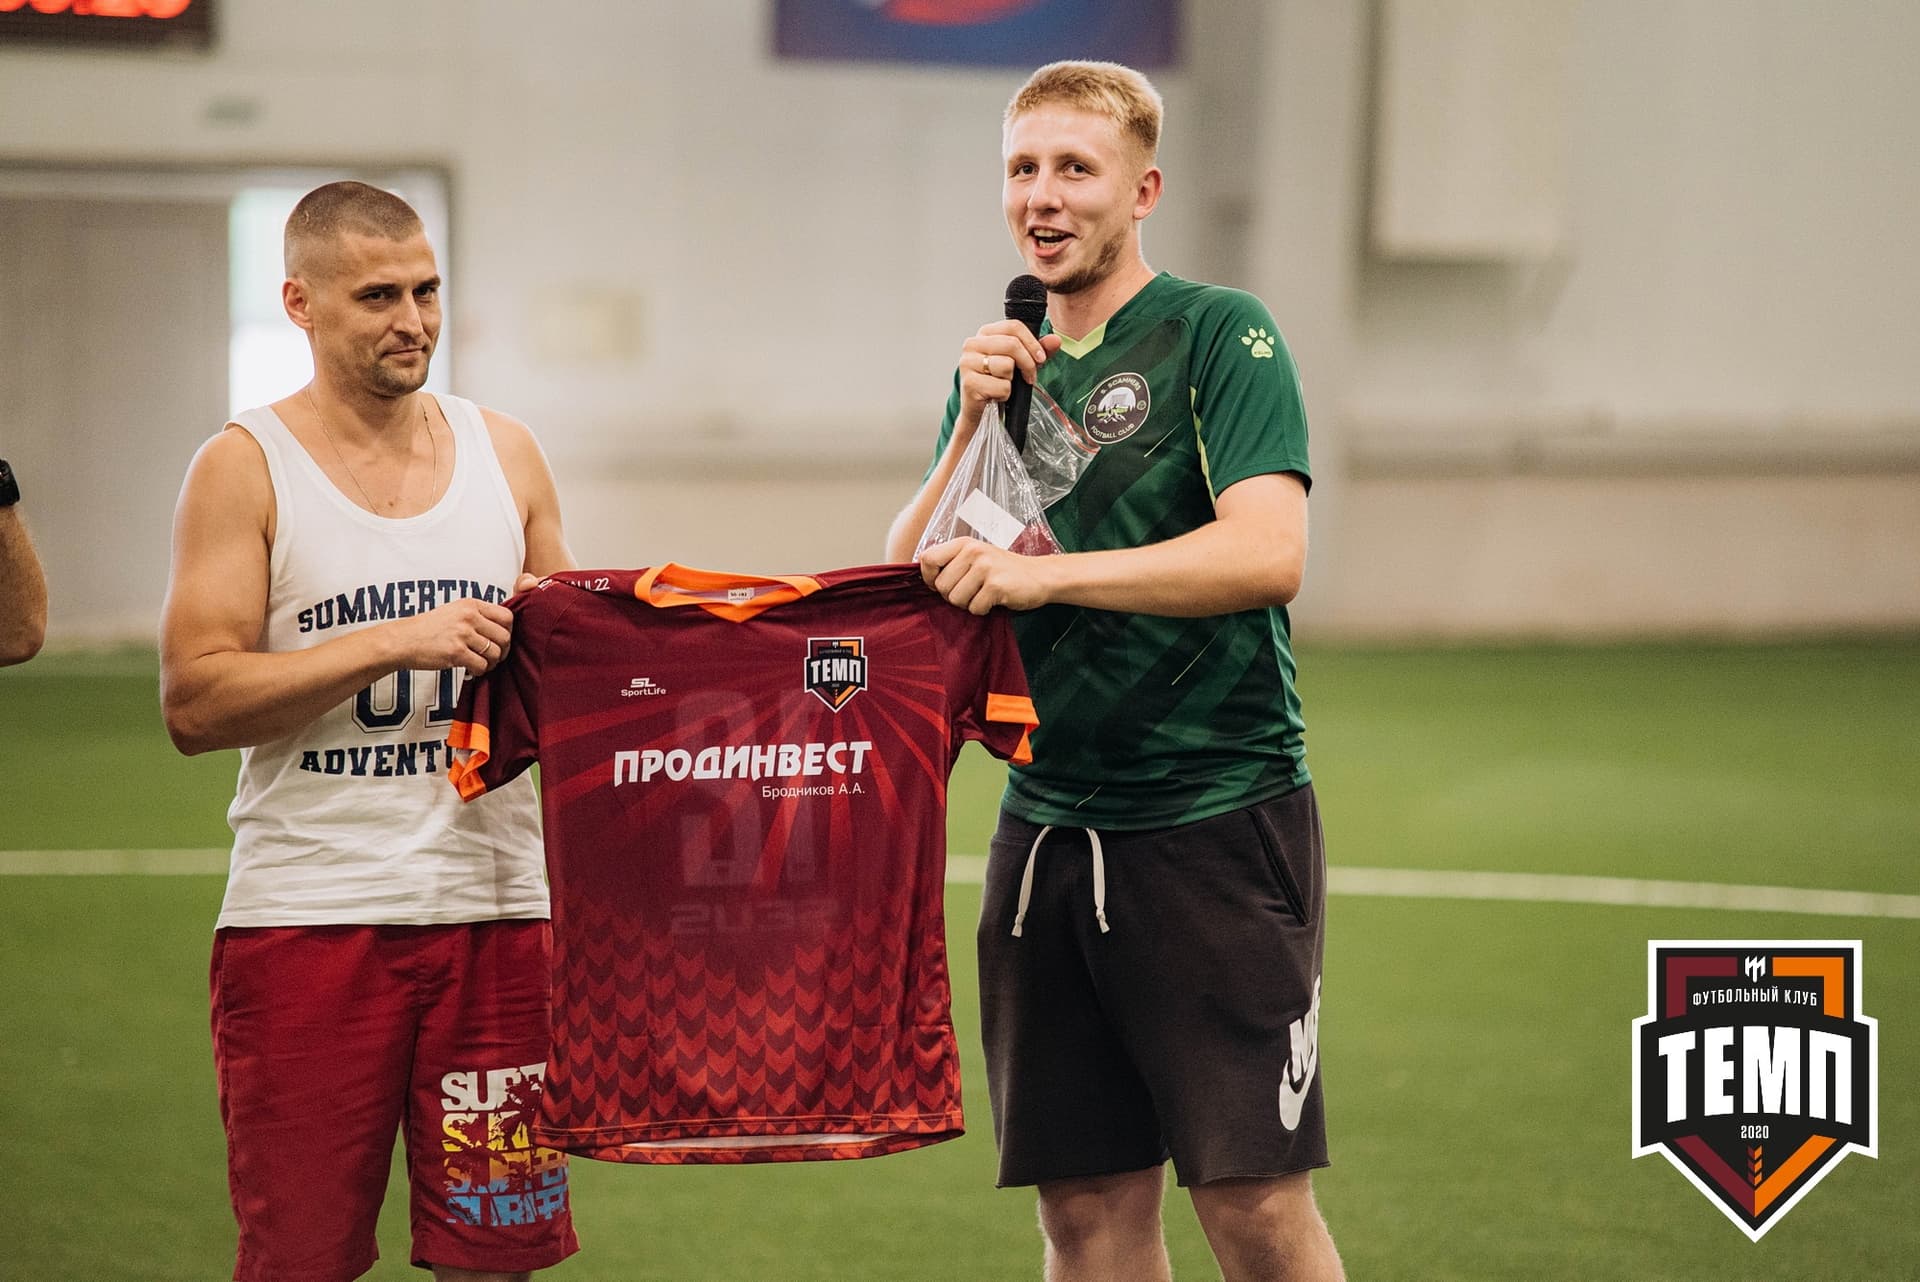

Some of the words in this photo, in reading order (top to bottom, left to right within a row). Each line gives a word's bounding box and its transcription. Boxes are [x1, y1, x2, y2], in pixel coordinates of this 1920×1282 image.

[1091, 425, 1117, 438] FOOTBALL
[1118, 423, 1135, 436] CLUB
[810, 658, 861, 684] ТЕМП
[621, 688, 667, 697] SportLife
[614, 741, 873, 787] ПРОДИНВЕСТ
[762, 784, 834, 800] Бродников
[838, 783, 865, 795] А.А.
